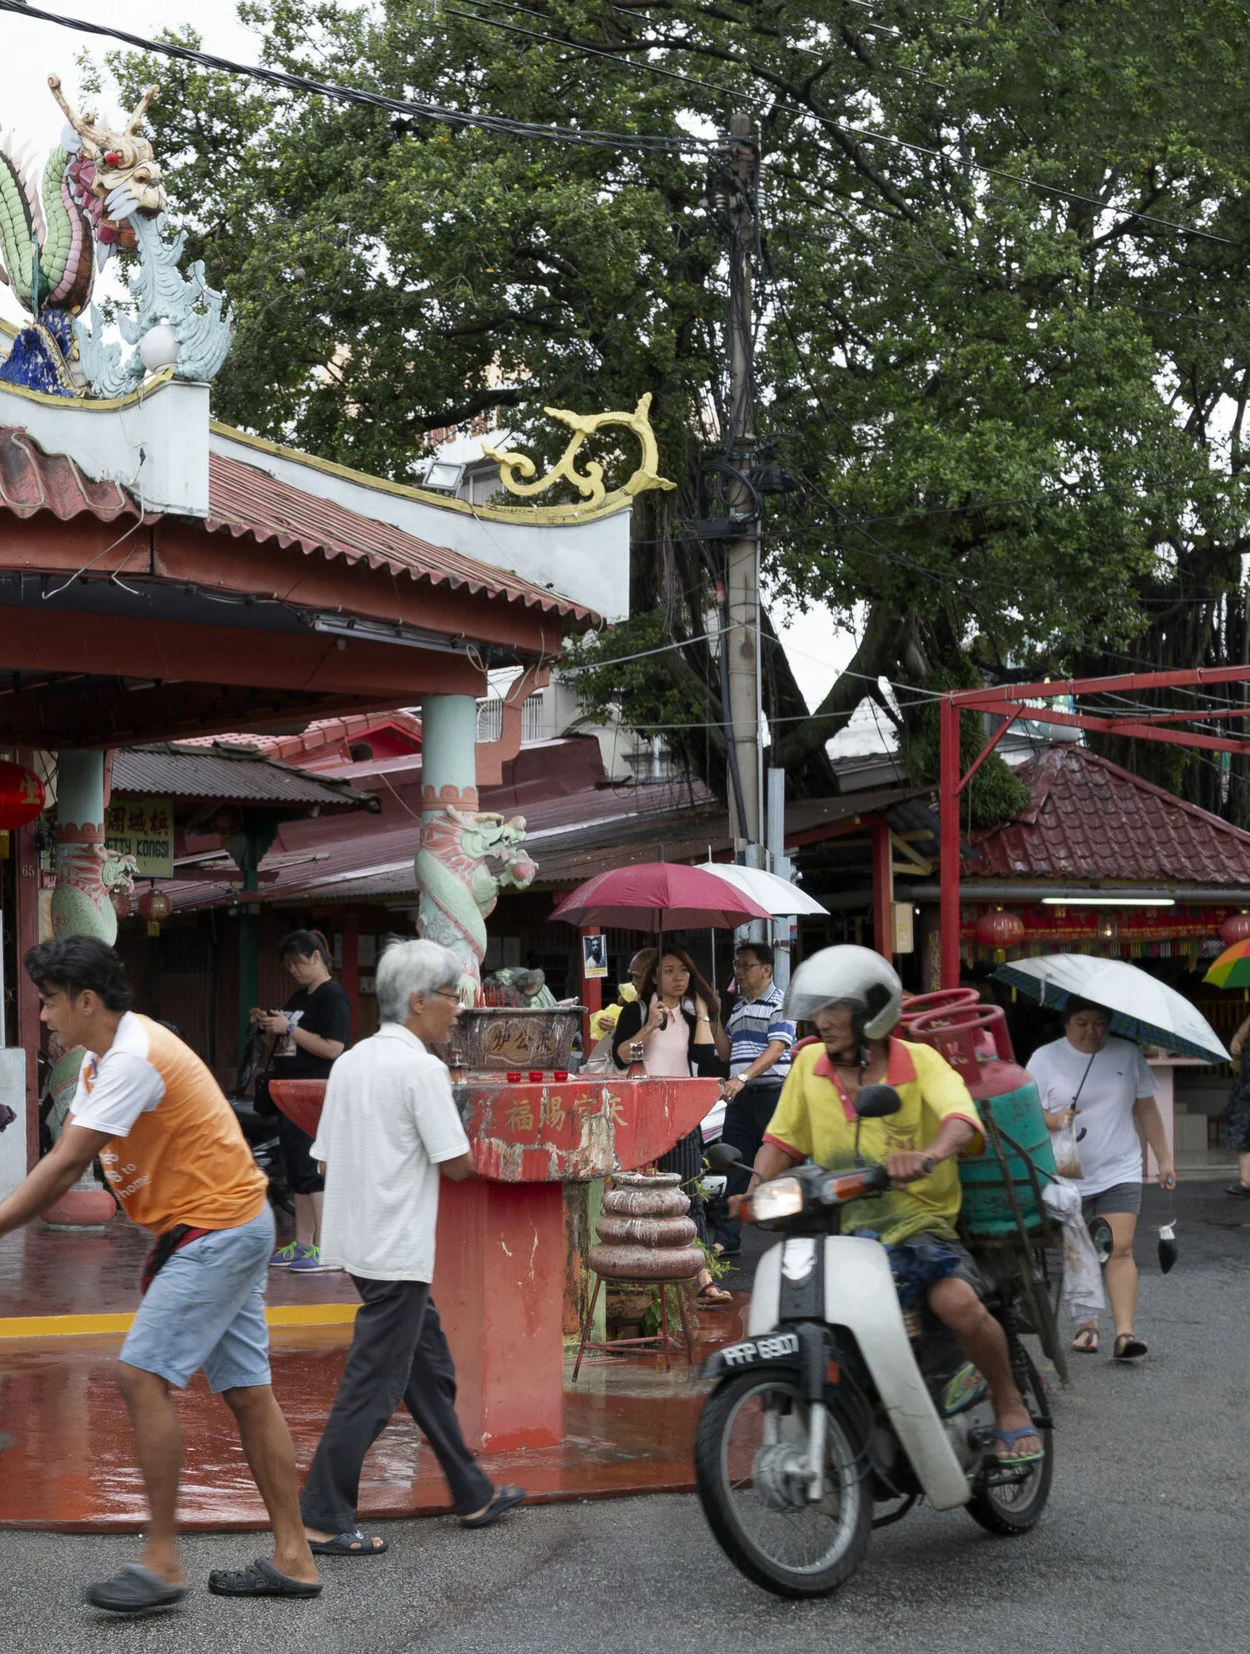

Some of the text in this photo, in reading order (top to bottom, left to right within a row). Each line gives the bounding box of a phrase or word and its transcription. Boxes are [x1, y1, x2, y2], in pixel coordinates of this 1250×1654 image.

[19, 773, 41, 805] 生
[104, 837, 169, 858] ETTY KONGSI
[22, 864, 35, 877] 65
